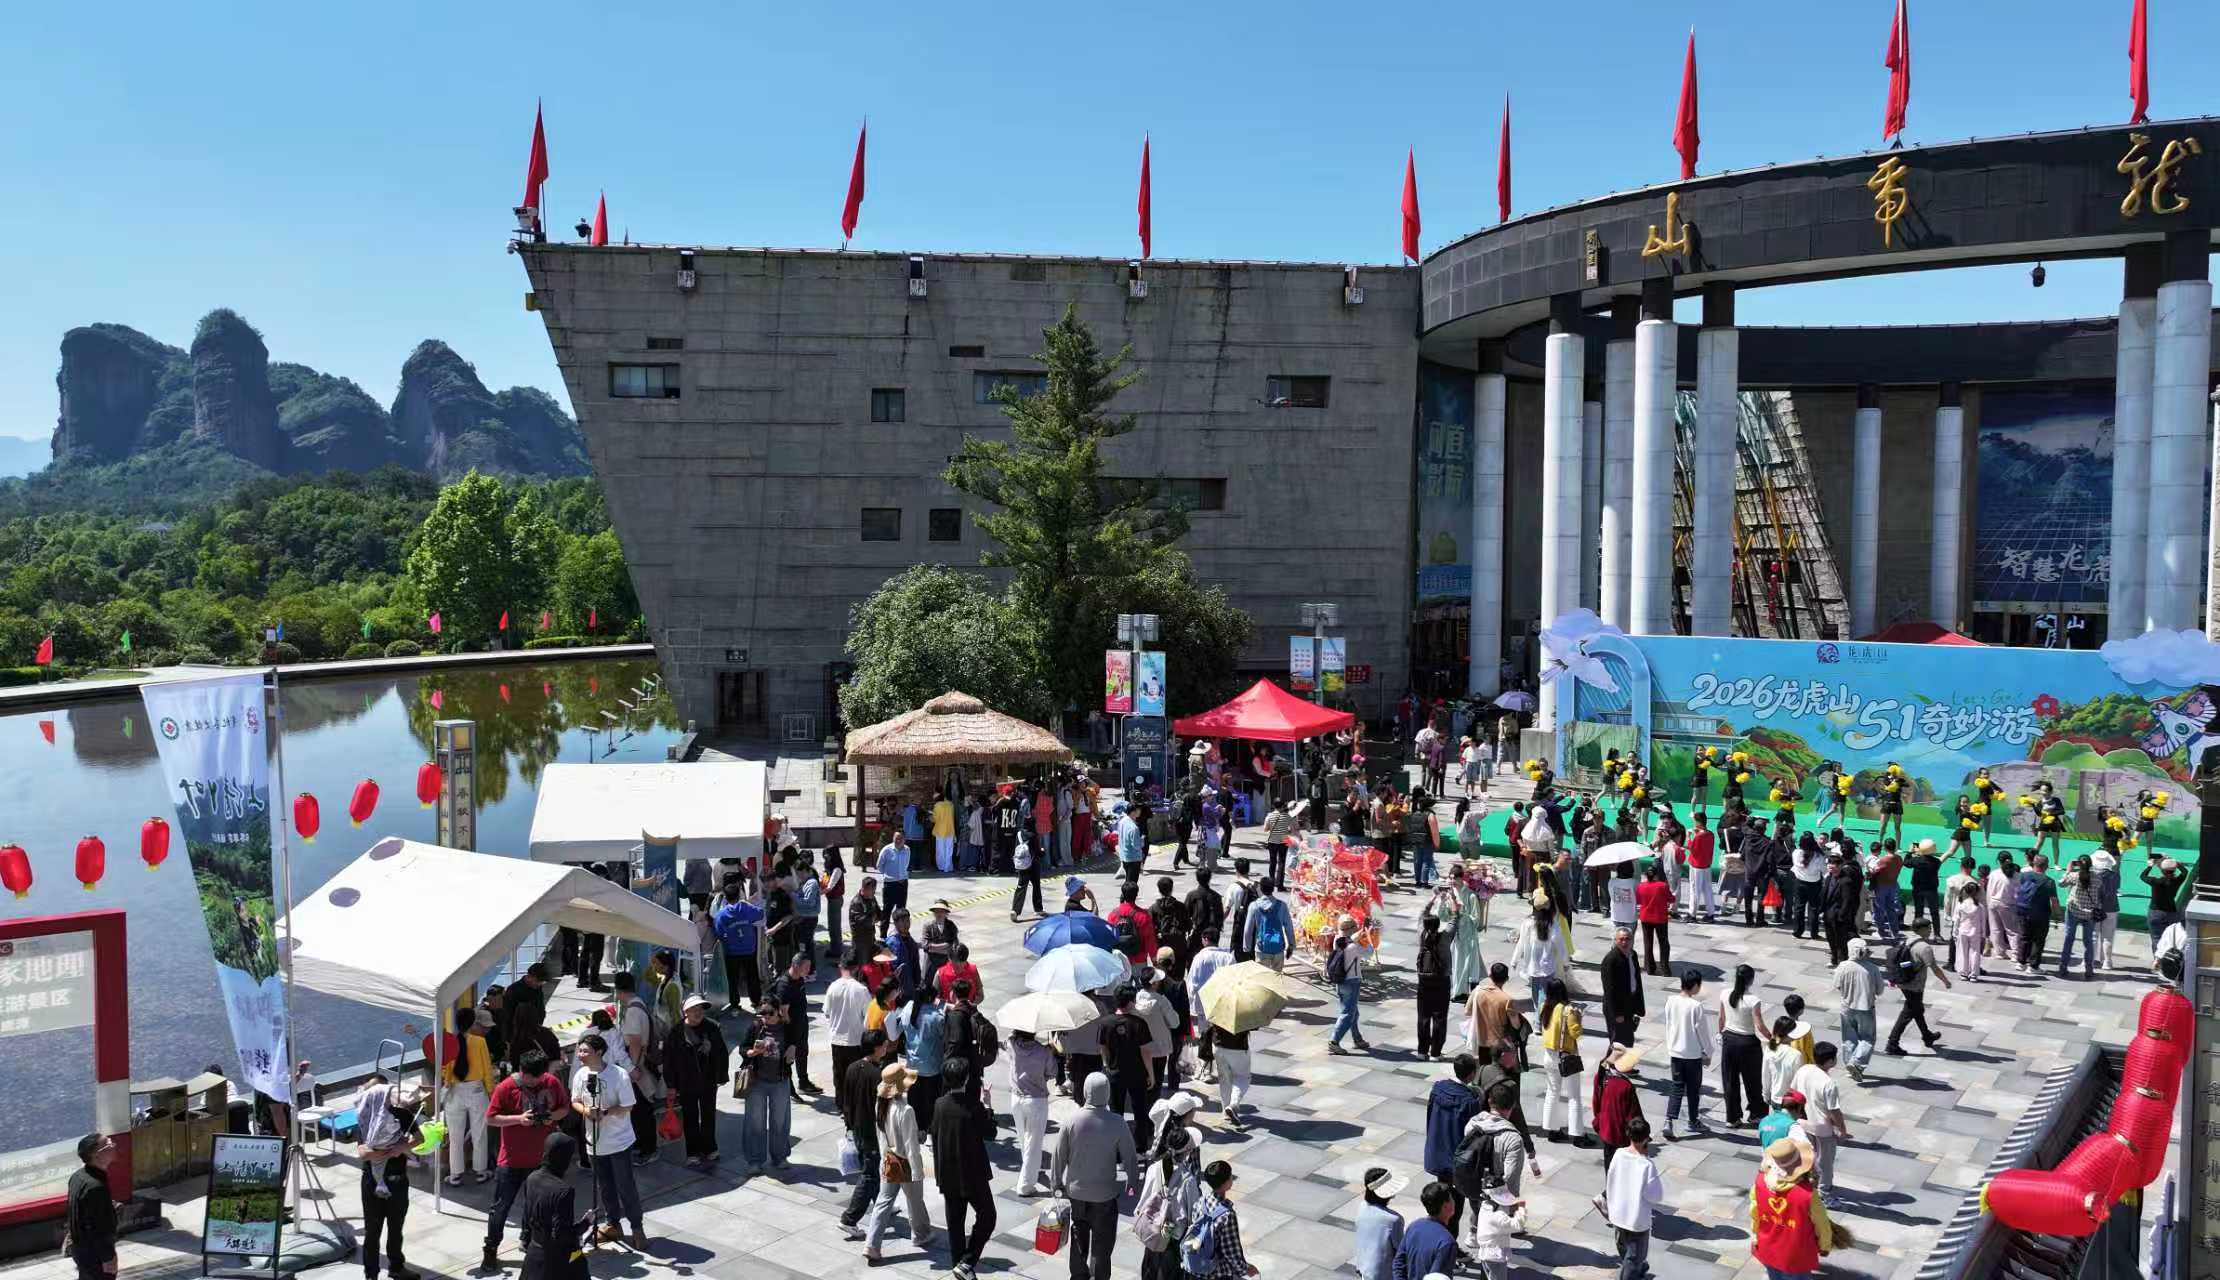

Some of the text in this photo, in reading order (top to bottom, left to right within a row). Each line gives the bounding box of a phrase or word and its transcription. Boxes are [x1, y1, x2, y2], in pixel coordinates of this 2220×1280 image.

[1687, 673, 1861, 720] 2026龙虎山
[1842, 699, 2045, 751] 5.1奇妙游
[0, 988, 72, 1014] 游景区
